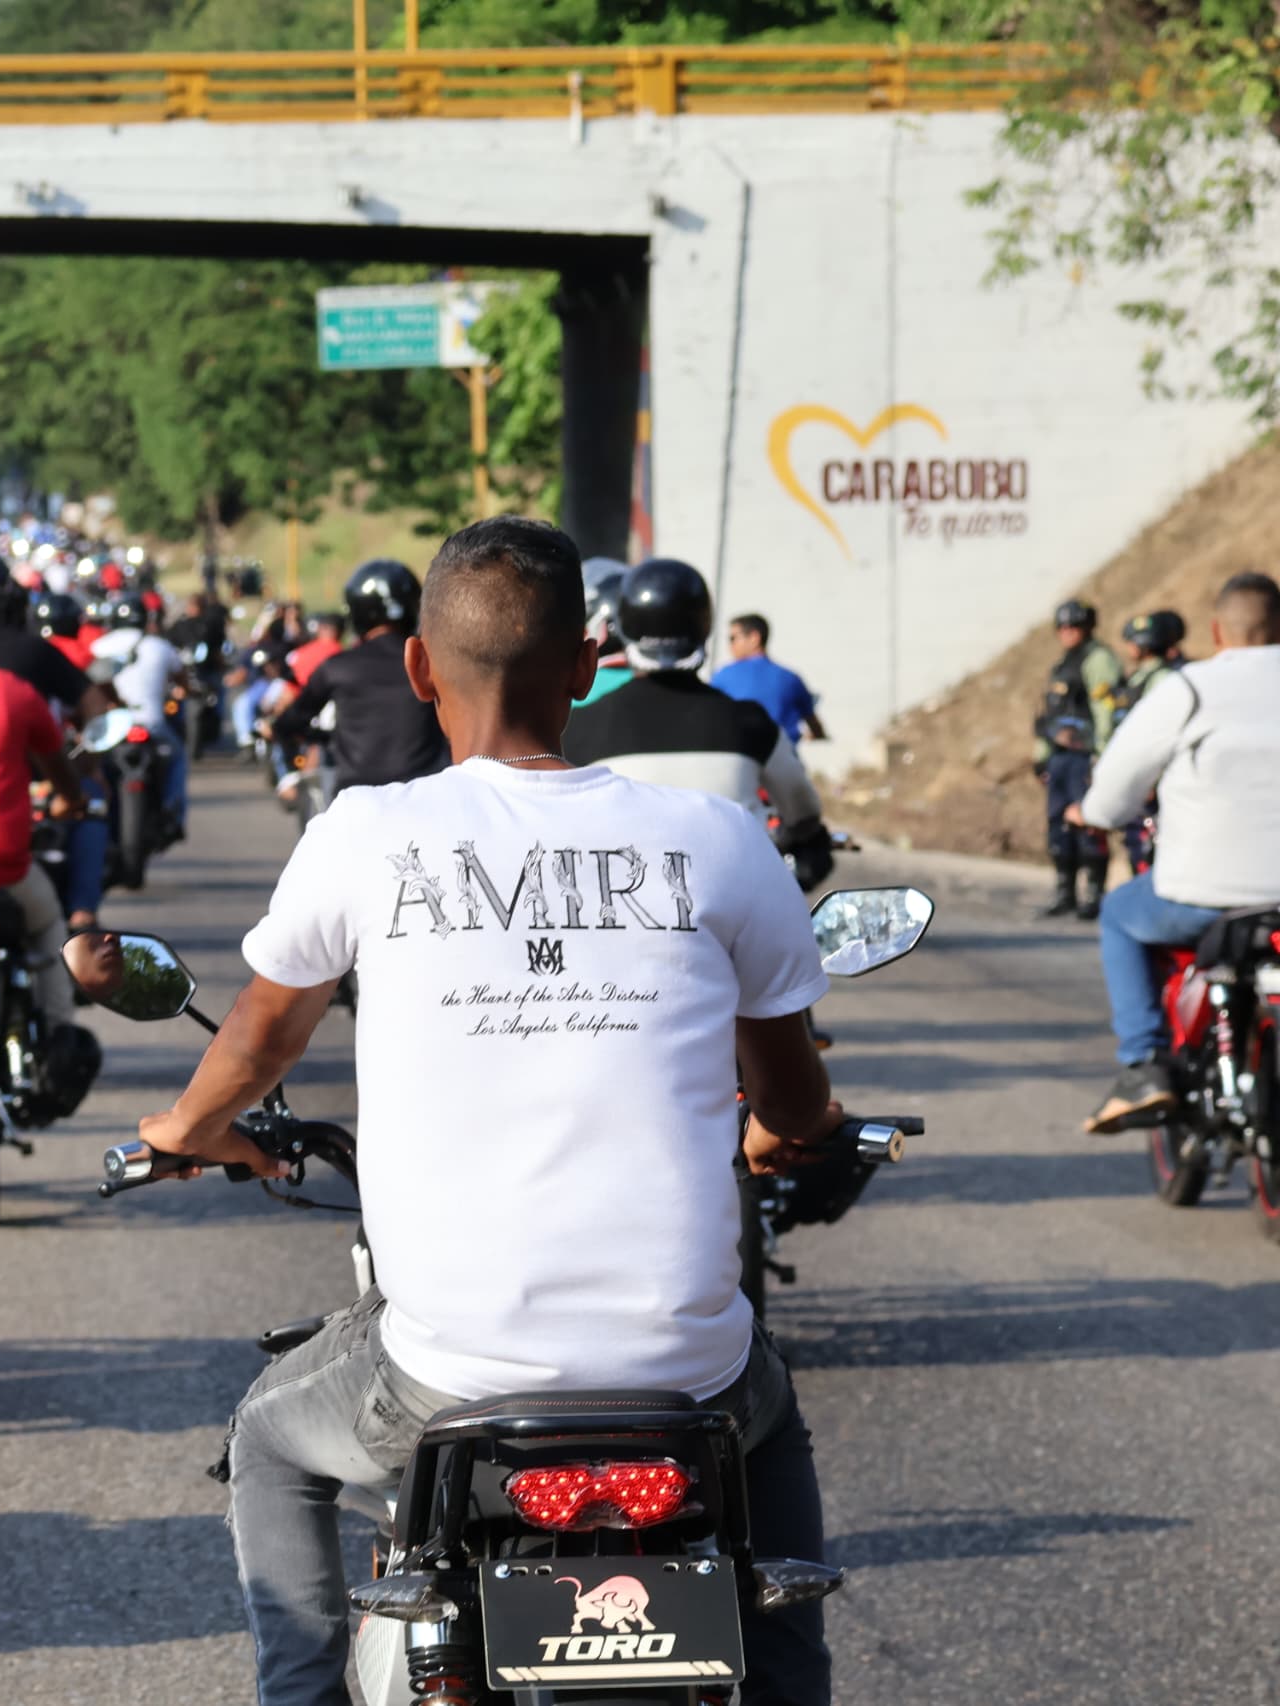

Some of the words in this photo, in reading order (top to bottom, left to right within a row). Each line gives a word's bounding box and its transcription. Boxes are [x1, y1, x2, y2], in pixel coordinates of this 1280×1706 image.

[823, 459, 1028, 502] CARABOBO
[386, 840, 698, 939] AMIRI
[441, 988, 462, 1007] the
[465, 983, 511, 1006] Heart
[514, 984, 534, 1010] of
[533, 986, 554, 1003] the
[557, 982, 594, 1002] Arts
[599, 982, 658, 1003] District
[467, 1014, 496, 1036] Los
[499, 1013, 558, 1040] Angeles
[564, 1011, 640, 1038] California
[538, 1633, 676, 1662] TORO
